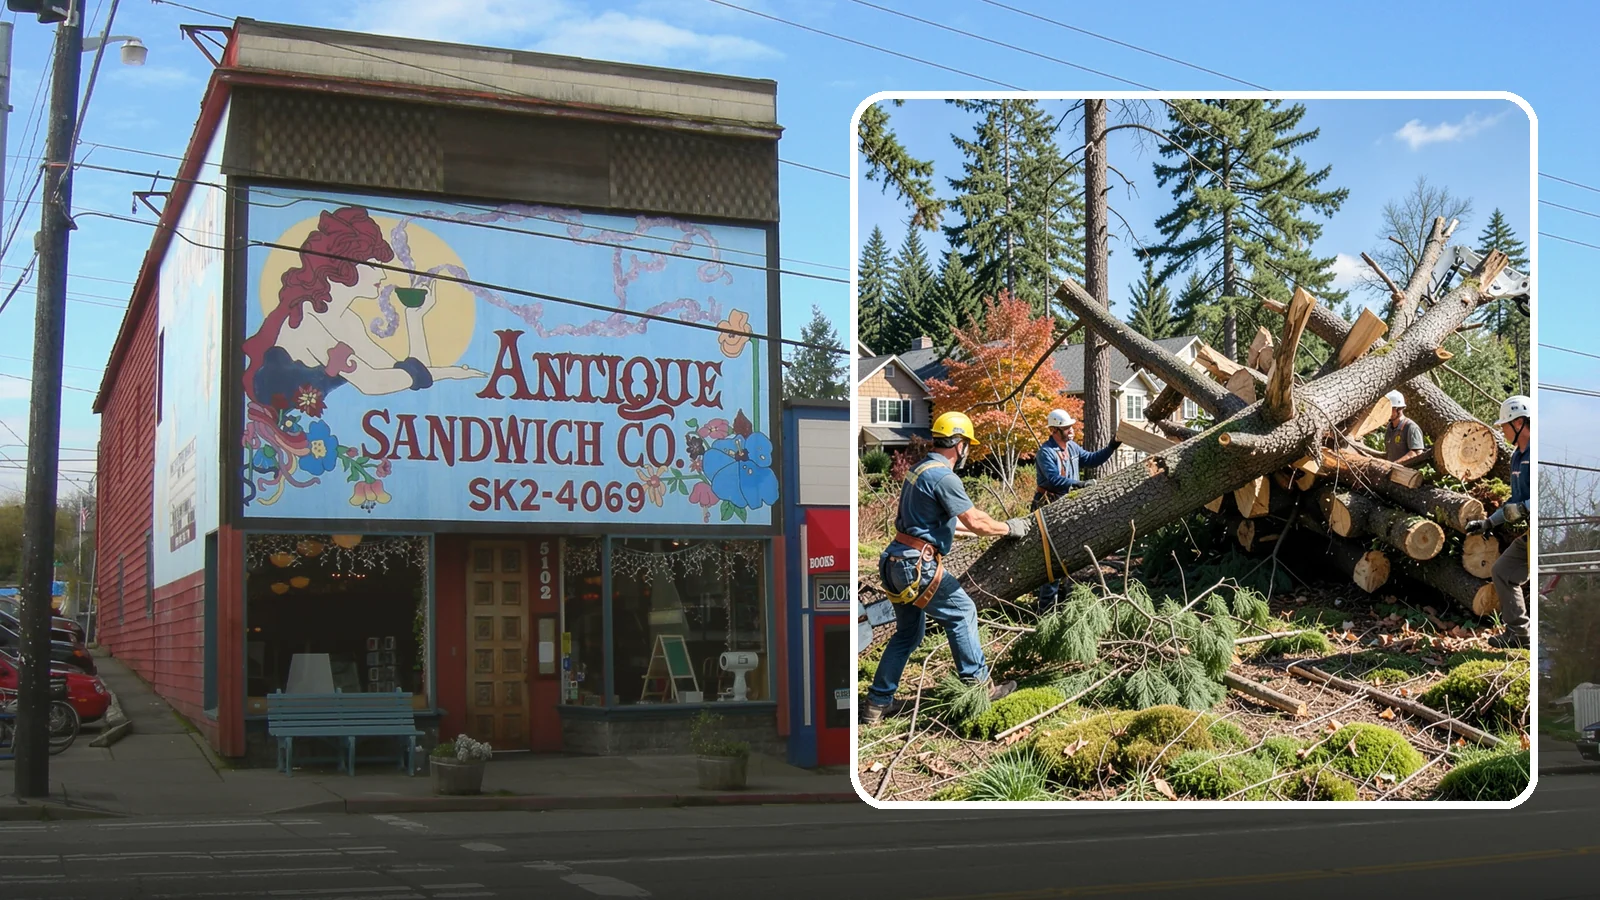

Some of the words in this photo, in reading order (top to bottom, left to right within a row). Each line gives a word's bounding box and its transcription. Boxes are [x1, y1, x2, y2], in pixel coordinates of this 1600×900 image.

[475, 328, 723, 421] ANTIQUE
[361, 408, 605, 467] SANDWICH
[617, 421, 685, 469] CO.
[468, 477, 646, 513] SK2-4069
[539, 541, 552, 600] 5102
[809, 554, 835, 569] BOOKS
